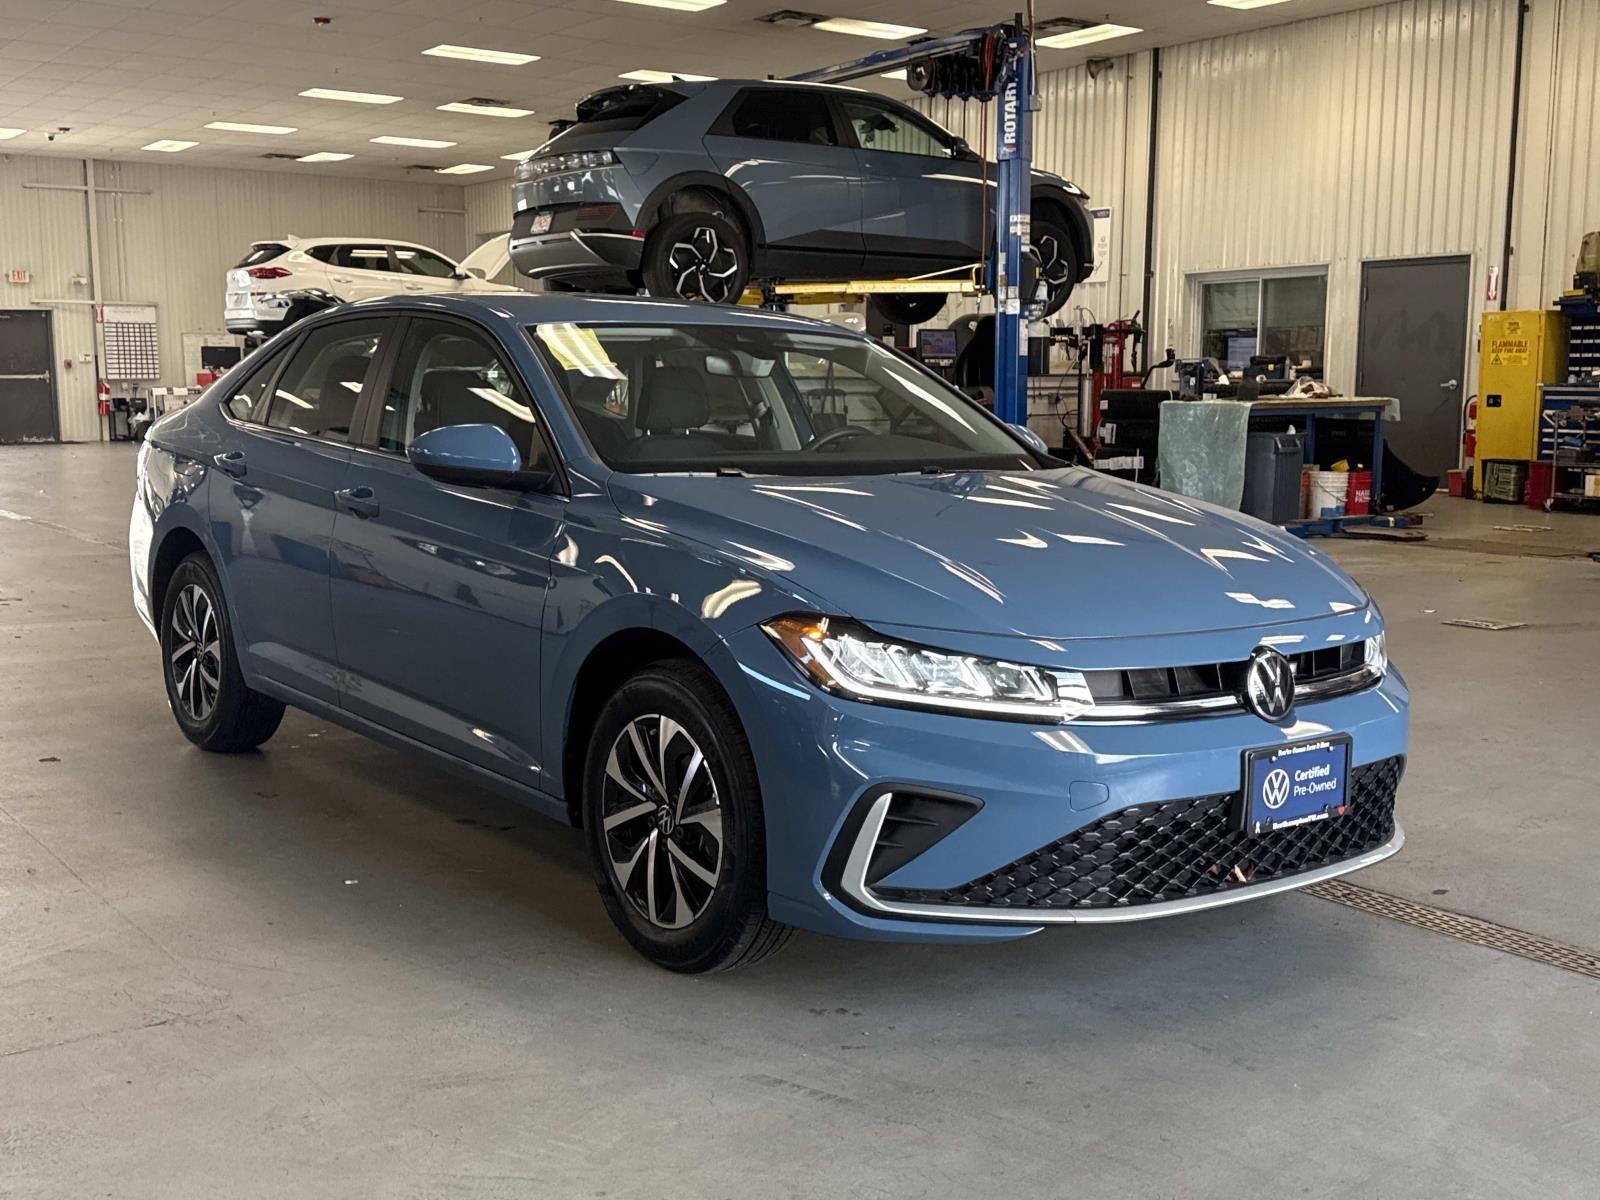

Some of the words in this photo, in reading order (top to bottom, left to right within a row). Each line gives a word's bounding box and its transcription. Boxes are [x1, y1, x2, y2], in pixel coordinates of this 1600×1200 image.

[12, 270, 26, 281] EXIT
[1491, 340, 1528, 348] FLAMMABLE
[1294, 764, 1331, 782] Certified
[1293, 778, 1337, 797] Pre-Owned
